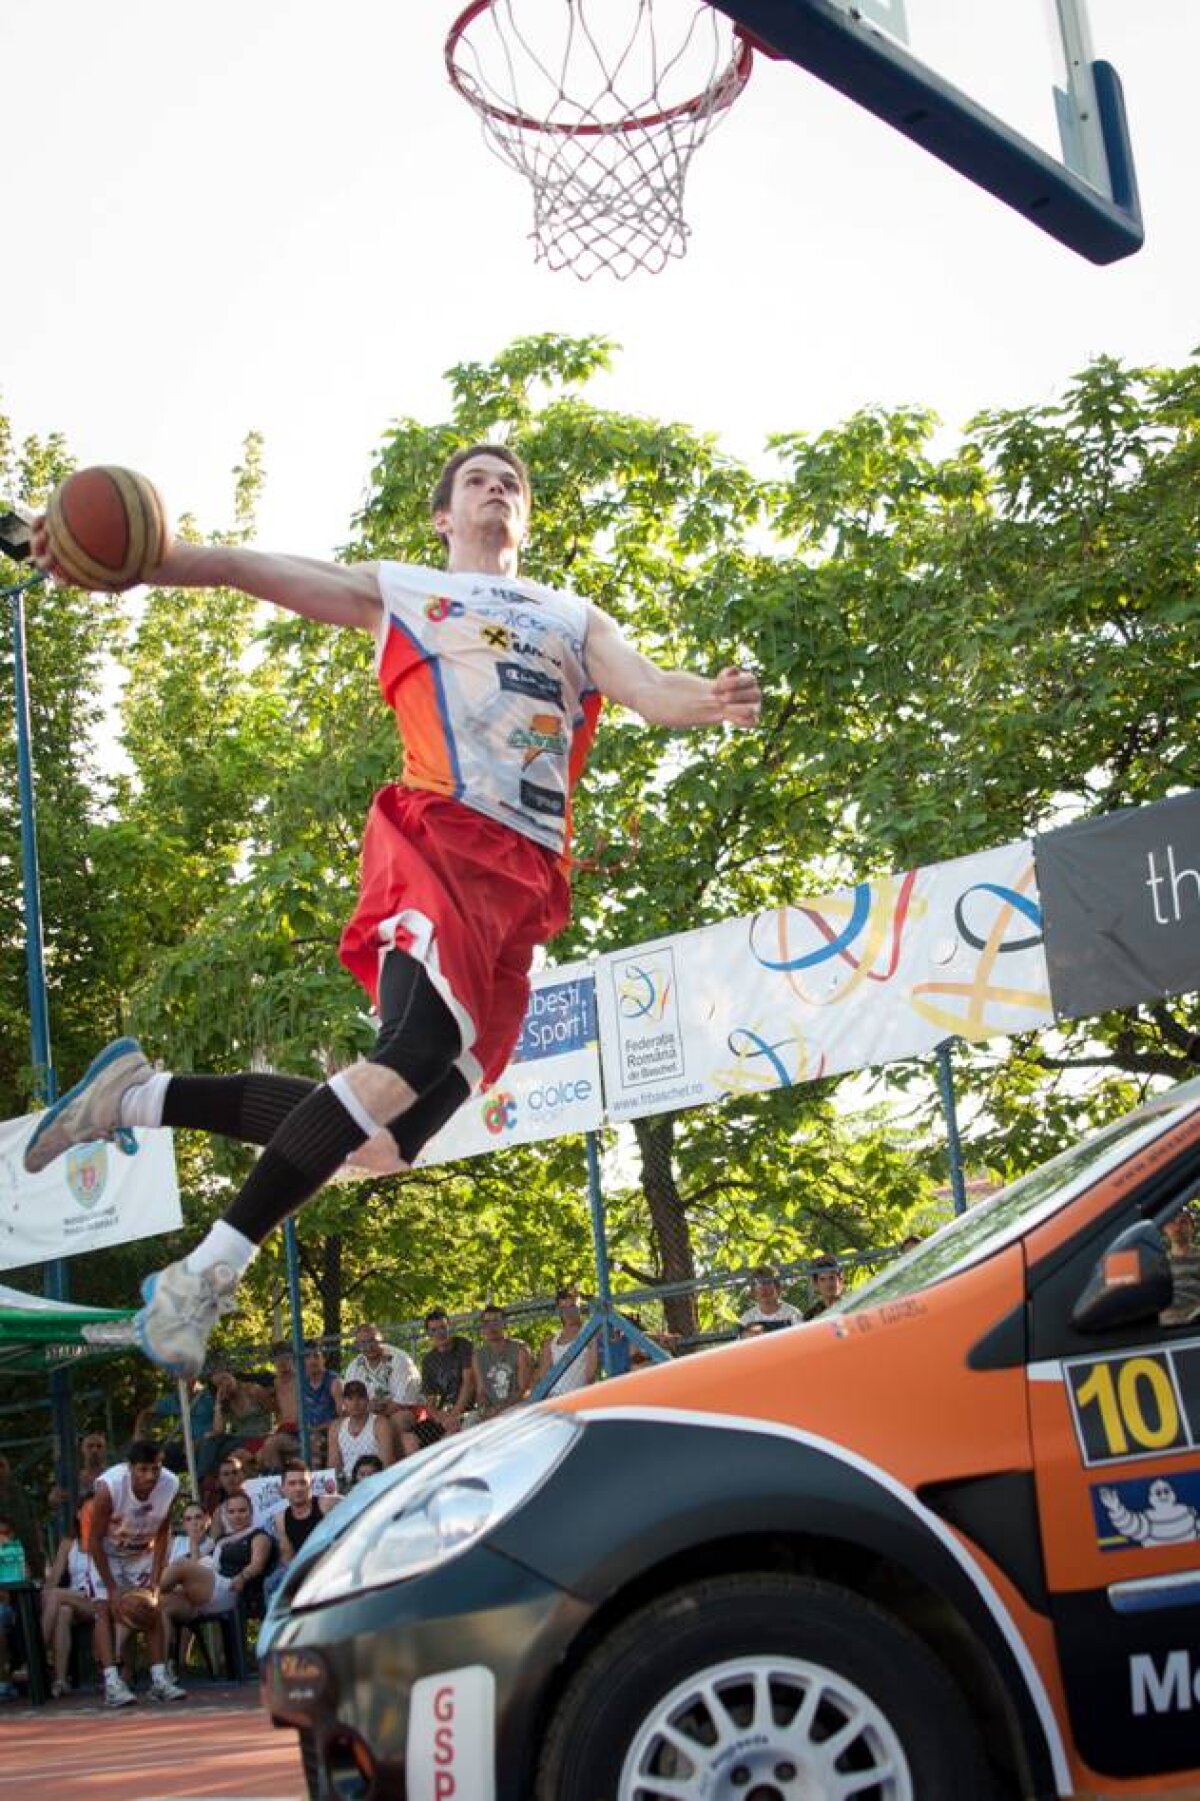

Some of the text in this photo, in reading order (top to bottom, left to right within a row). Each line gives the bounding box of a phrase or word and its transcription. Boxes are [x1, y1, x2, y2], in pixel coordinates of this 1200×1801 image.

[1146, 845, 1200, 924] th
[528, 1079, 592, 1110] dolce
[1077, 1356, 1178, 1455] 10
[1129, 1649, 1200, 1716] M
